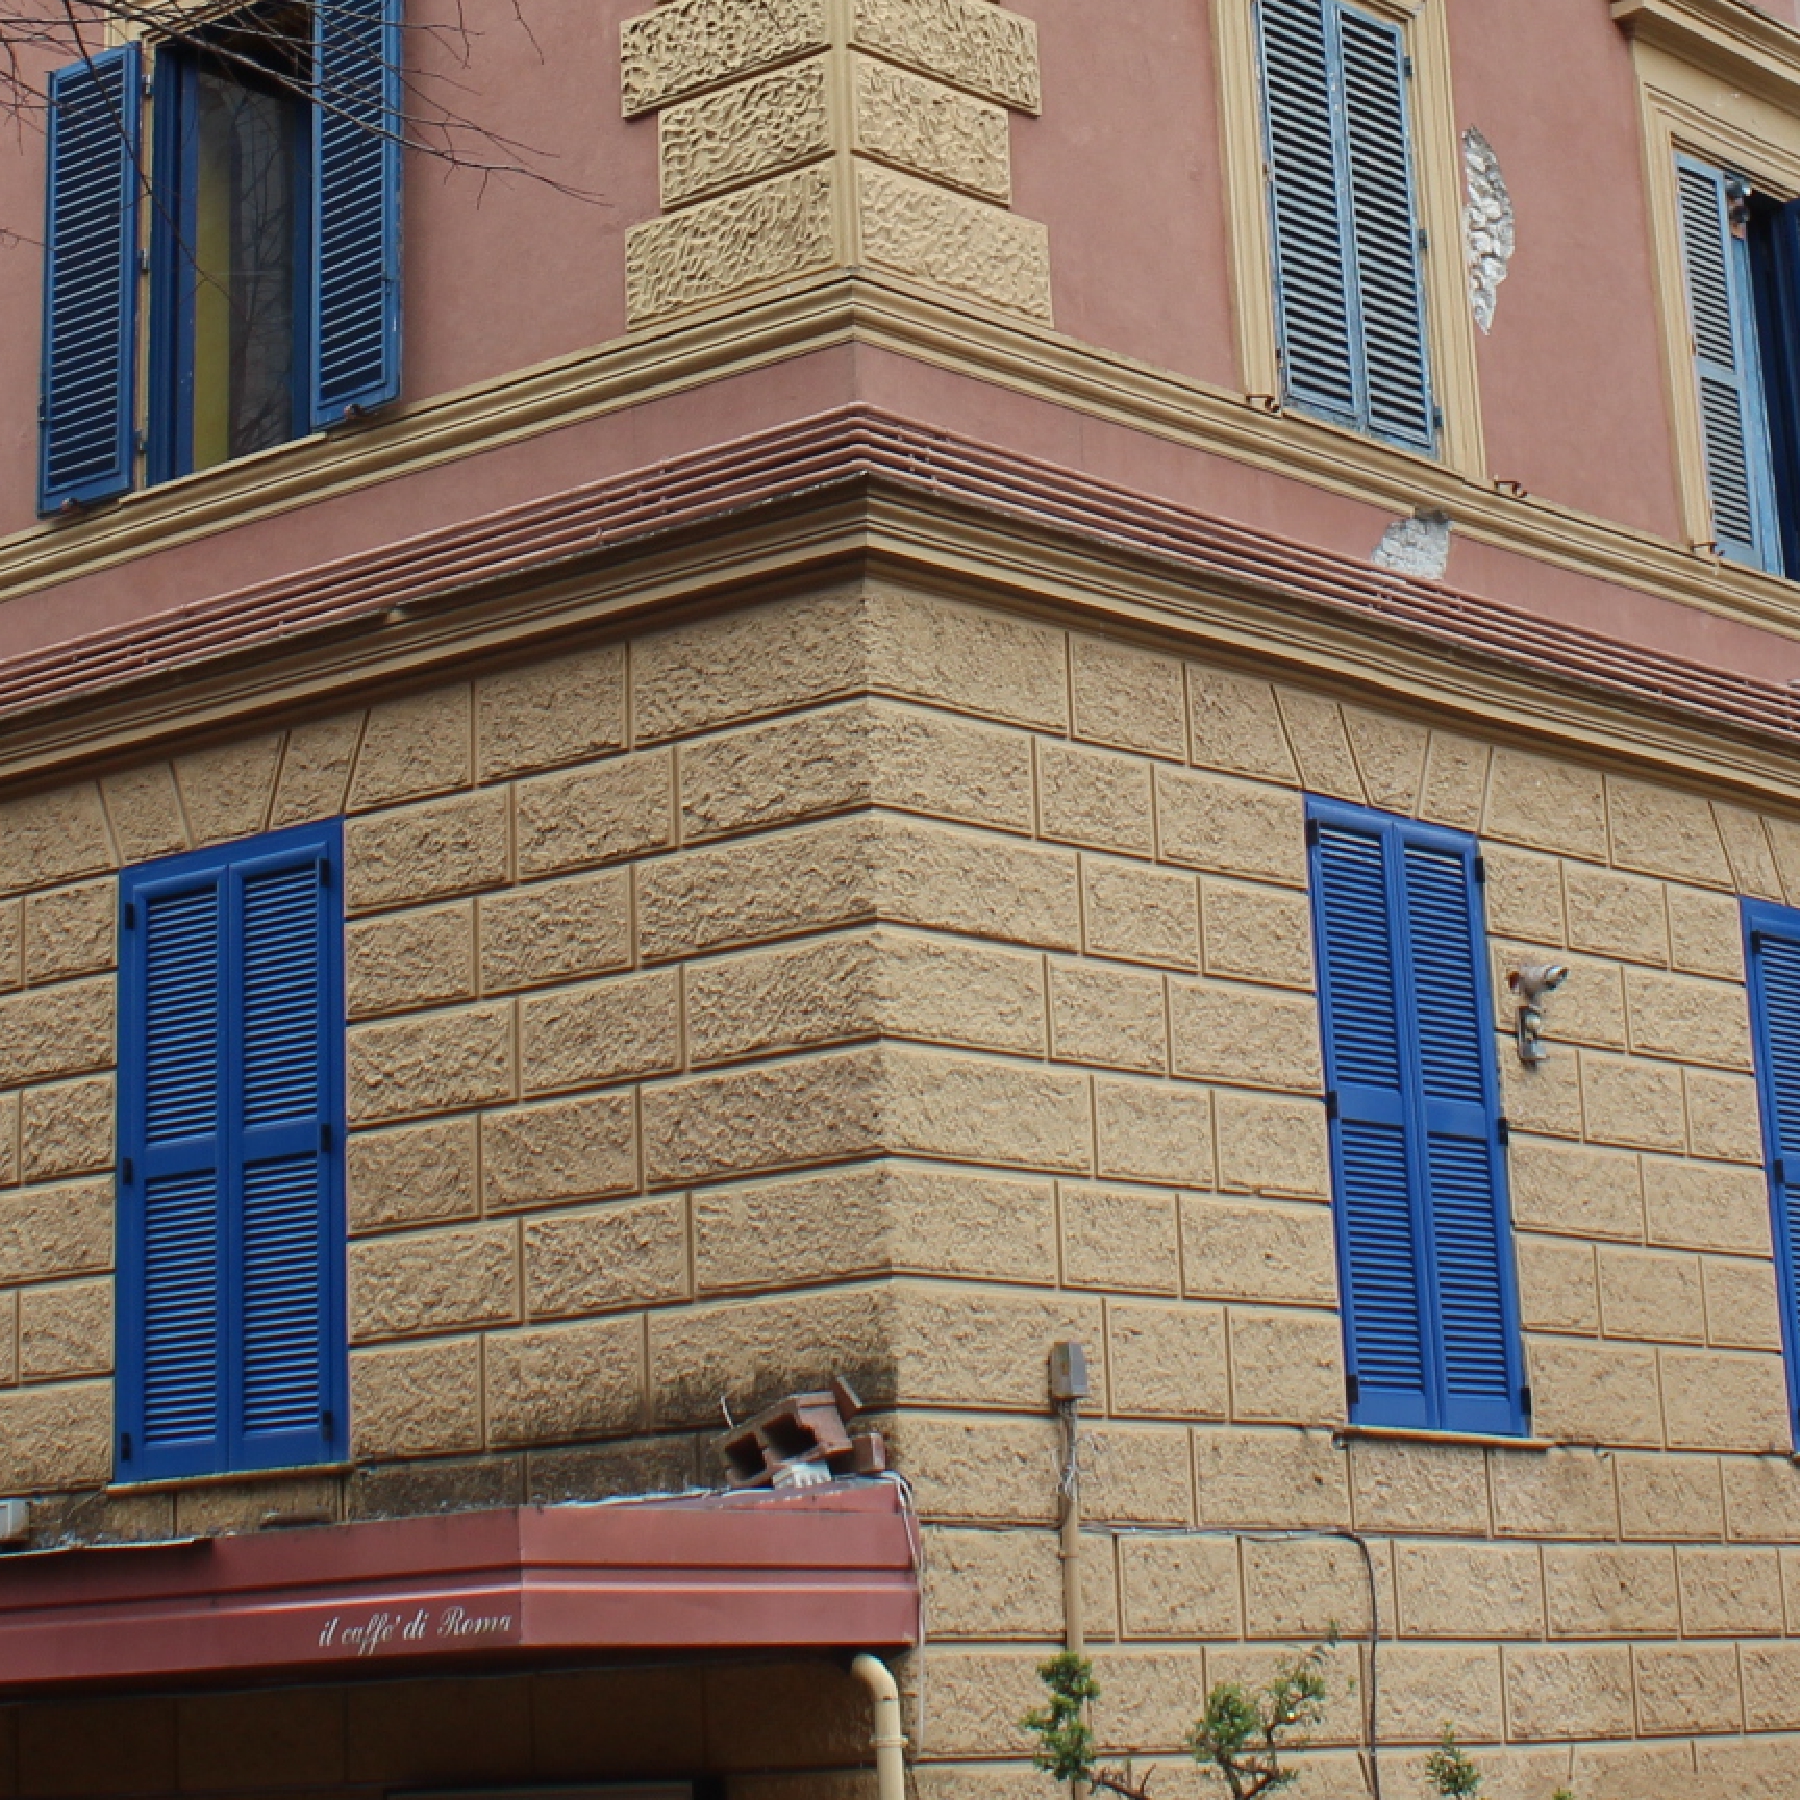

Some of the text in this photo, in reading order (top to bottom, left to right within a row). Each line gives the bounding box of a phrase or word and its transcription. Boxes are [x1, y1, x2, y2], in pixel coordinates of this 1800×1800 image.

[318, 1616, 340, 1647] il
[403, 1607, 429, 1641] di
[437, 1605, 513, 1639] Roma
